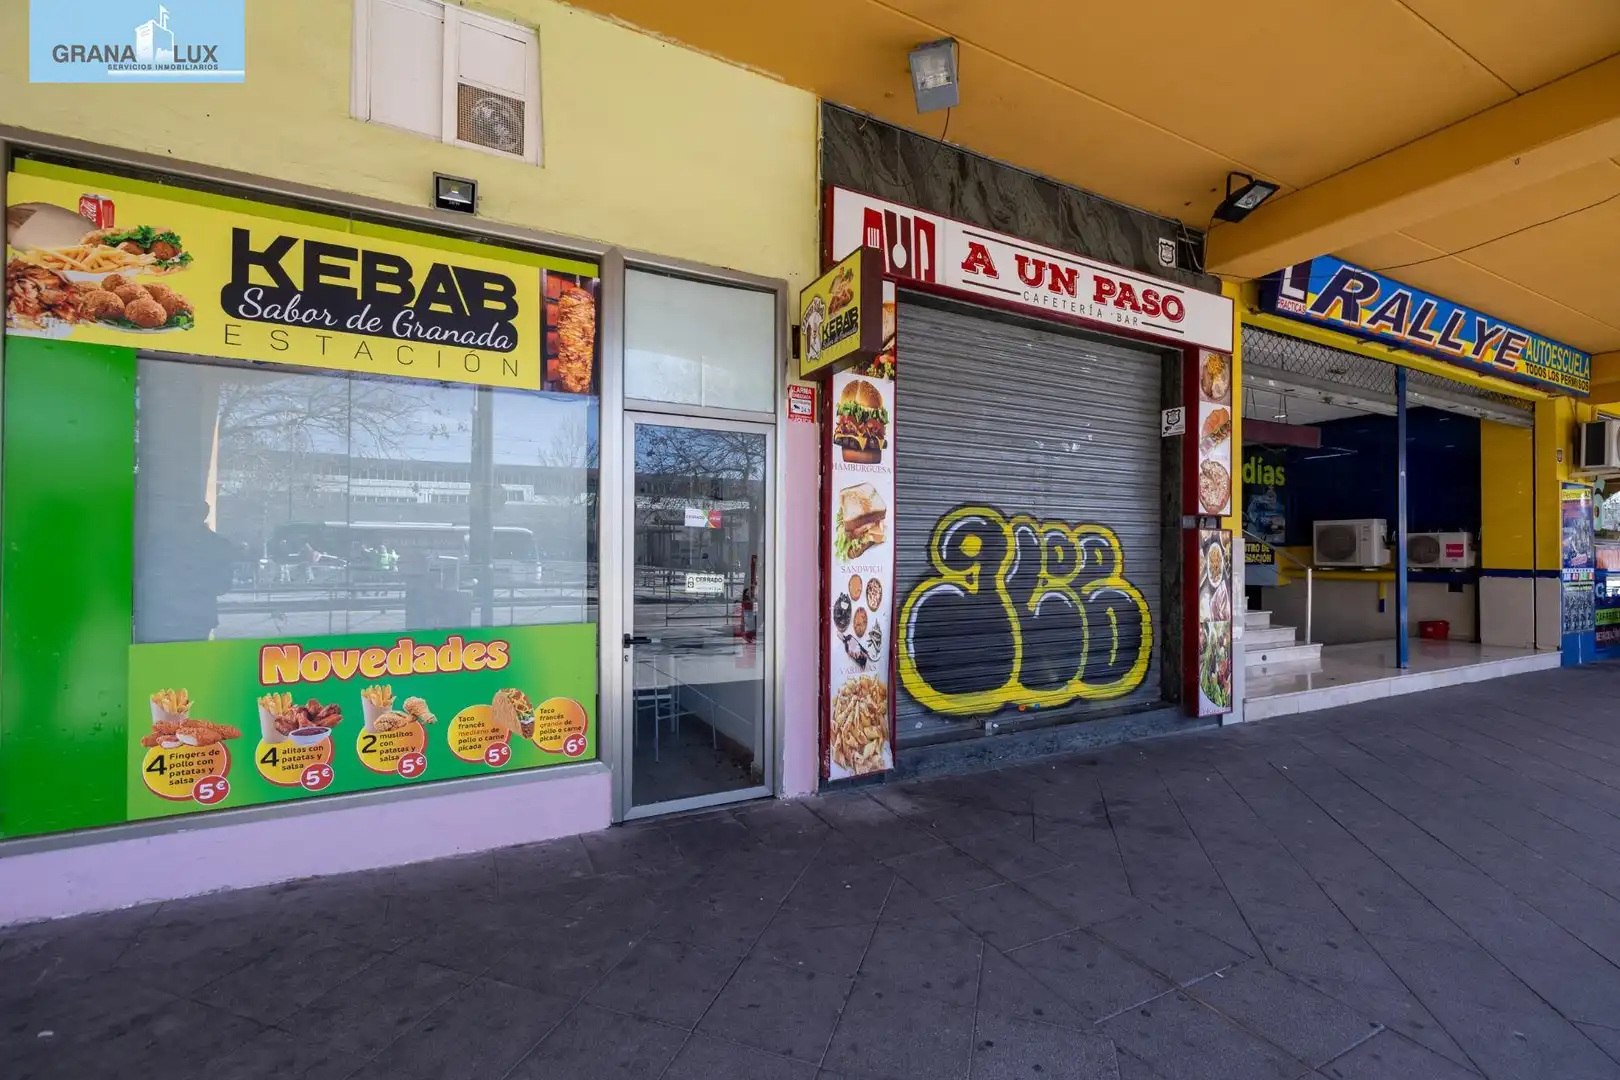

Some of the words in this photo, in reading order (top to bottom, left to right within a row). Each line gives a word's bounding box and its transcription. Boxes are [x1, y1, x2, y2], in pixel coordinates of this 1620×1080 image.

[231, 227, 519, 320] KEBAB
[961, 241, 999, 279] A
[1014, 253, 1078, 298] UN
[1093, 274, 1185, 323] PASO
[1023, 290, 1103, 318] CAFETERÍA
[1116, 312, 1139, 326] BAR
[238, 287, 338, 327] Sabor
[346, 304, 383, 332] de
[392, 309, 513, 350] Granada
[822, 306, 858, 342] KEBAB
[1306, 264, 1529, 372] RALLYE
[224, 324, 518, 377] ESTACIÓN
[1525, 335, 1591, 380] AUTOESCUELA
[1525, 362, 1547, 379] TODOS
[1547, 370, 1560, 383] LOS
[1560, 374, 1589, 391] PERMISOS
[832, 462, 892, 474] HAMBURGUESA
[1242, 456, 1285, 486] días
[841, 565, 883, 574] SANDWICH
[259, 635, 511, 687] Novedades
[540, 713, 564, 721] francés
[458, 721, 485, 730] francés
[540, 728, 557, 736] pollo
[379, 731, 414, 740] muslitos
[458, 737, 477, 745] pollo
[540, 735, 561, 743] picada
[282, 746, 306, 755] alitas
[308, 744, 324, 752] con
[361, 734, 377, 754] 2
[379, 746, 409, 755] patatas
[458, 744, 482, 752] picada
[566, 737, 586, 753] 6€
[169, 750, 206, 760] Fingers
[208, 748, 220, 756] de
[260, 747, 279, 767] 4
[282, 754, 315, 764] patatas
[379, 754, 400, 762] salsa
[488, 746, 508, 763] 5€
[146, 754, 167, 775] 4
[169, 760, 194, 770] pollo
[196, 758, 214, 766] con
[282, 763, 304, 771] salsa
[402, 756, 424, 774] 5€
[168, 776, 194, 785] salsa
[169, 768, 206, 778] patatas
[306, 767, 330, 786] 5€
[199, 780, 226, 799] 5€
